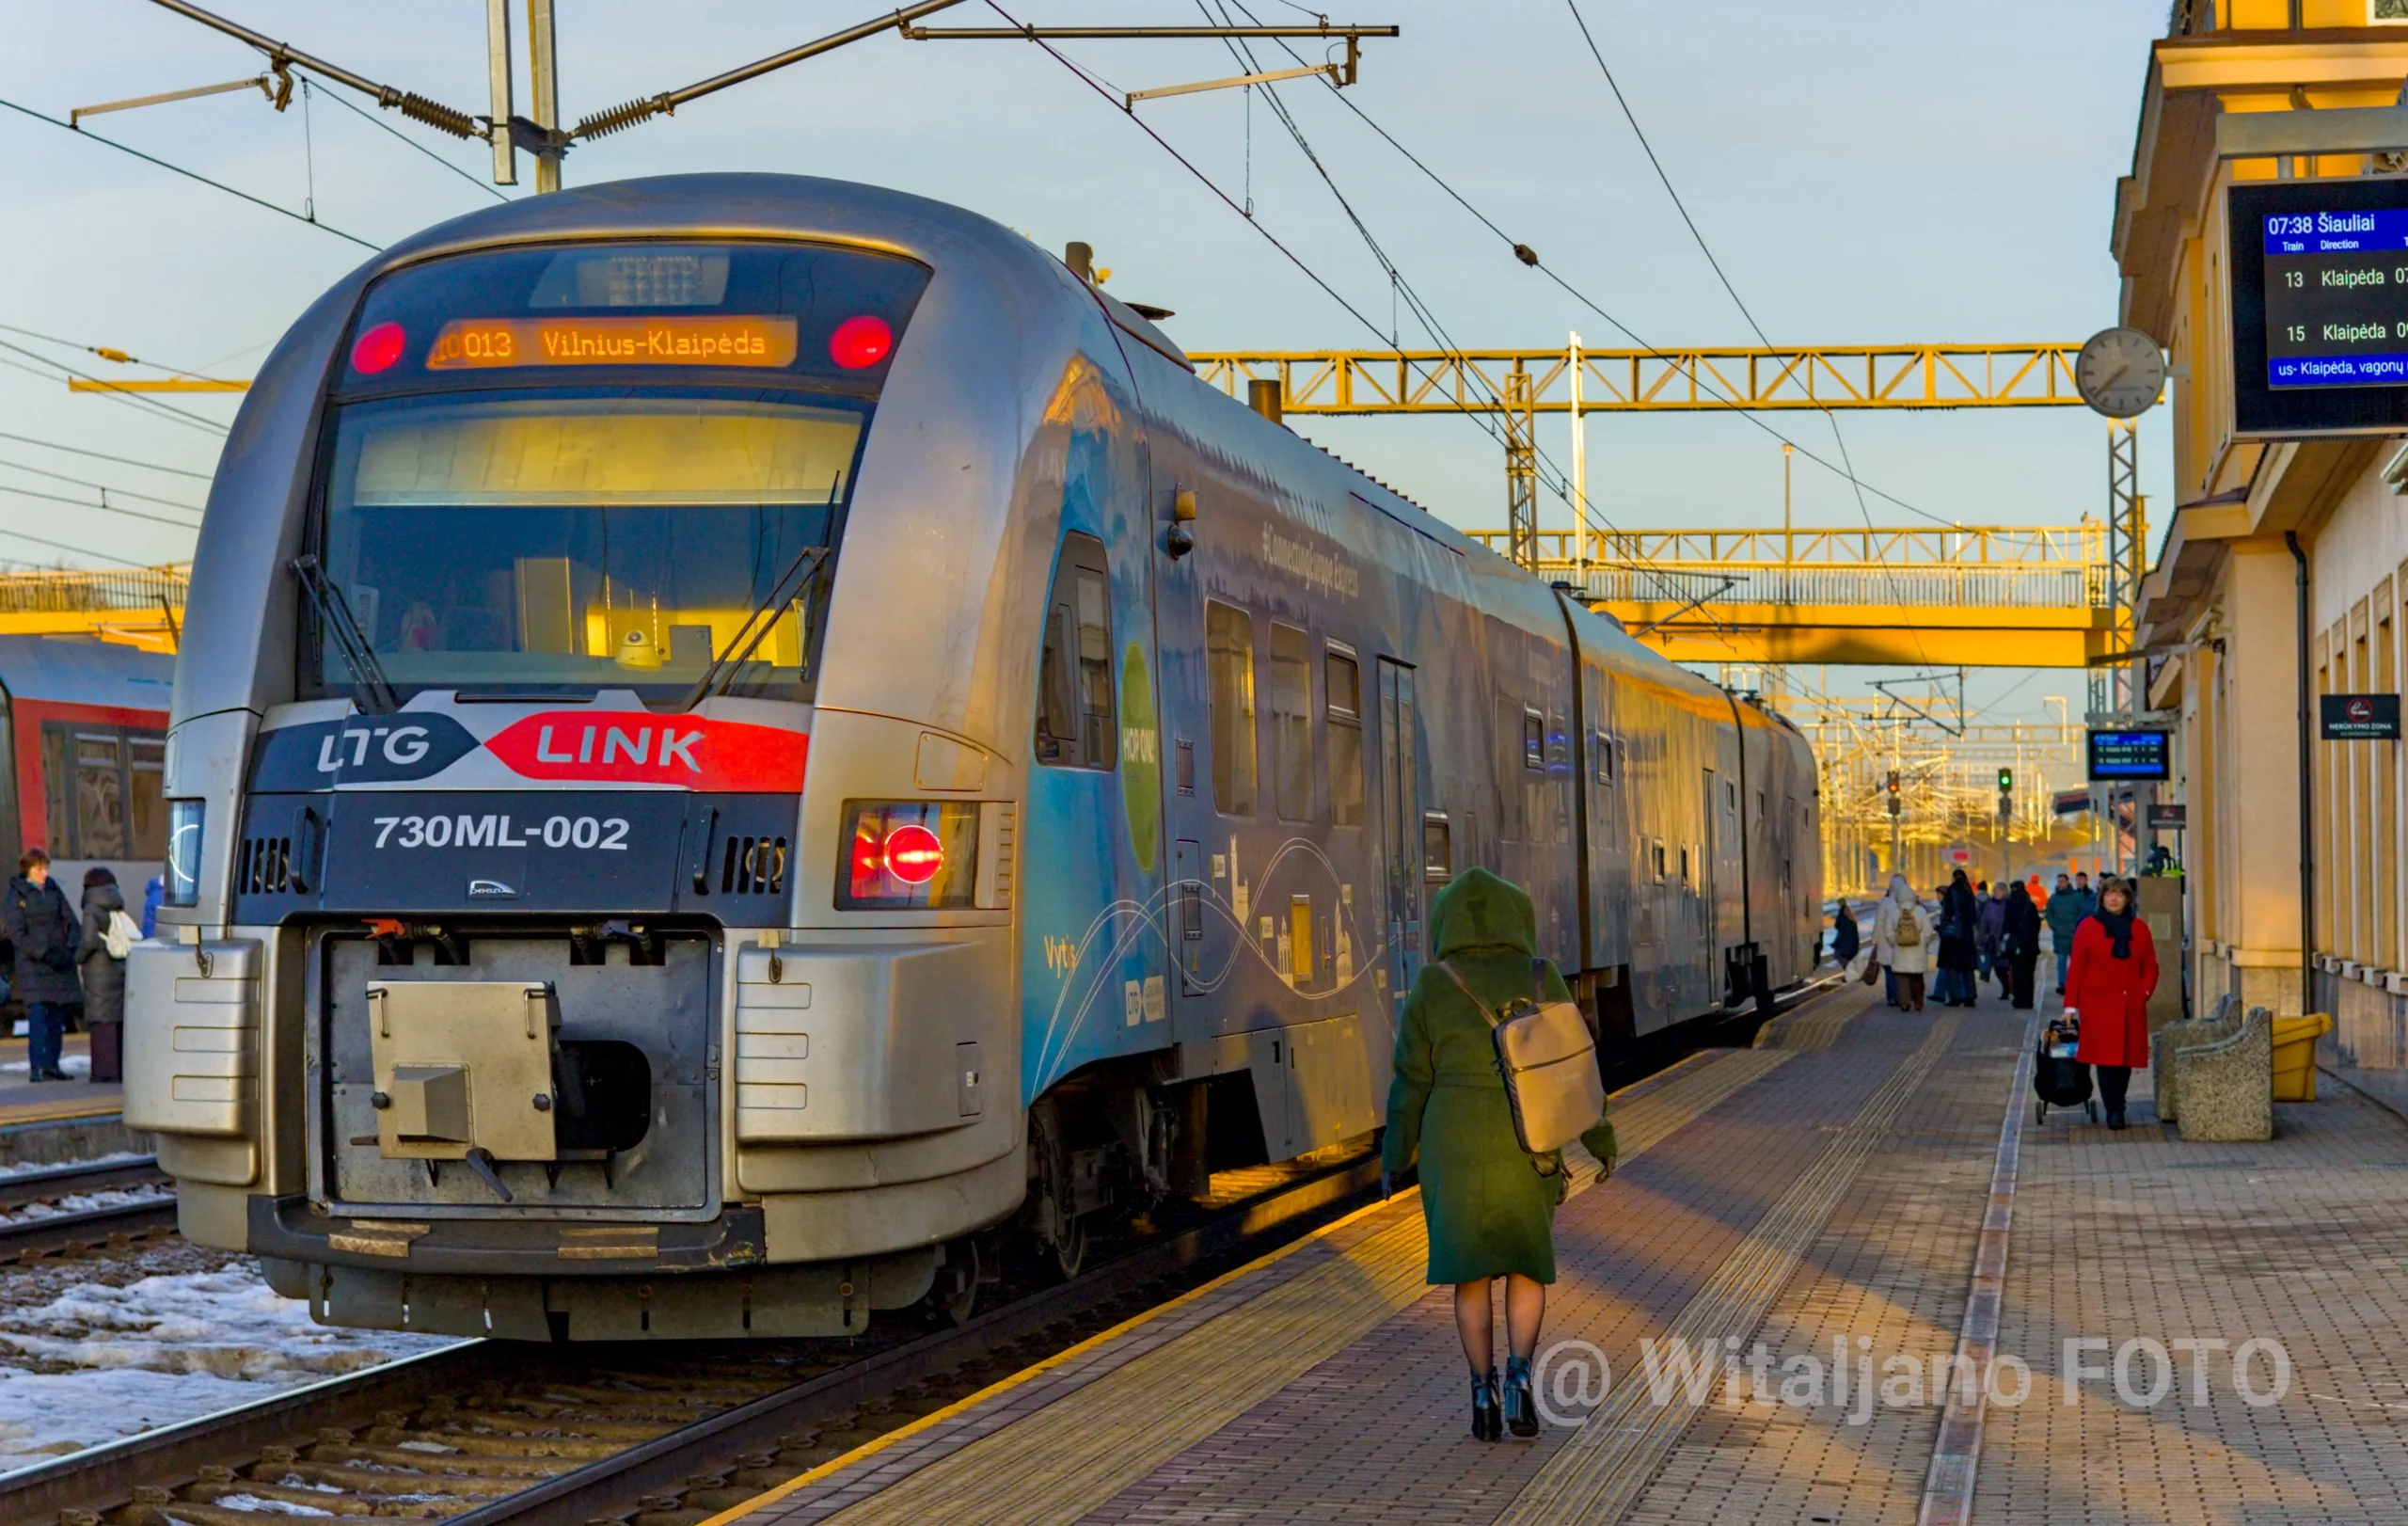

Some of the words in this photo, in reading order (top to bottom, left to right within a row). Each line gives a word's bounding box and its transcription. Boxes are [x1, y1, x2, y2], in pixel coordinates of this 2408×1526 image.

[2268, 215, 2313, 235] 07:38
[2318, 211, 2375, 233] Šiauliai
[2282, 241, 2305, 252] Train
[2320, 239, 2359, 250] Direction
[2285, 271, 2304, 288] 13
[2321, 268, 2384, 289] Klaipėda
[544, 330, 766, 358] Vilnius-Klaipėda
[2287, 326, 2305, 342] 15
[2322, 323, 2386, 343] Klaipėda
[2301, 359, 2356, 377] Klaipėda,
[2370, 722, 2392, 730] ZONA
[317, 726, 431, 773] LTG
[535, 724, 706, 774] LINK
[1122, 726, 1139, 763] HOP
[373, 814, 630, 851] 730ML-002
